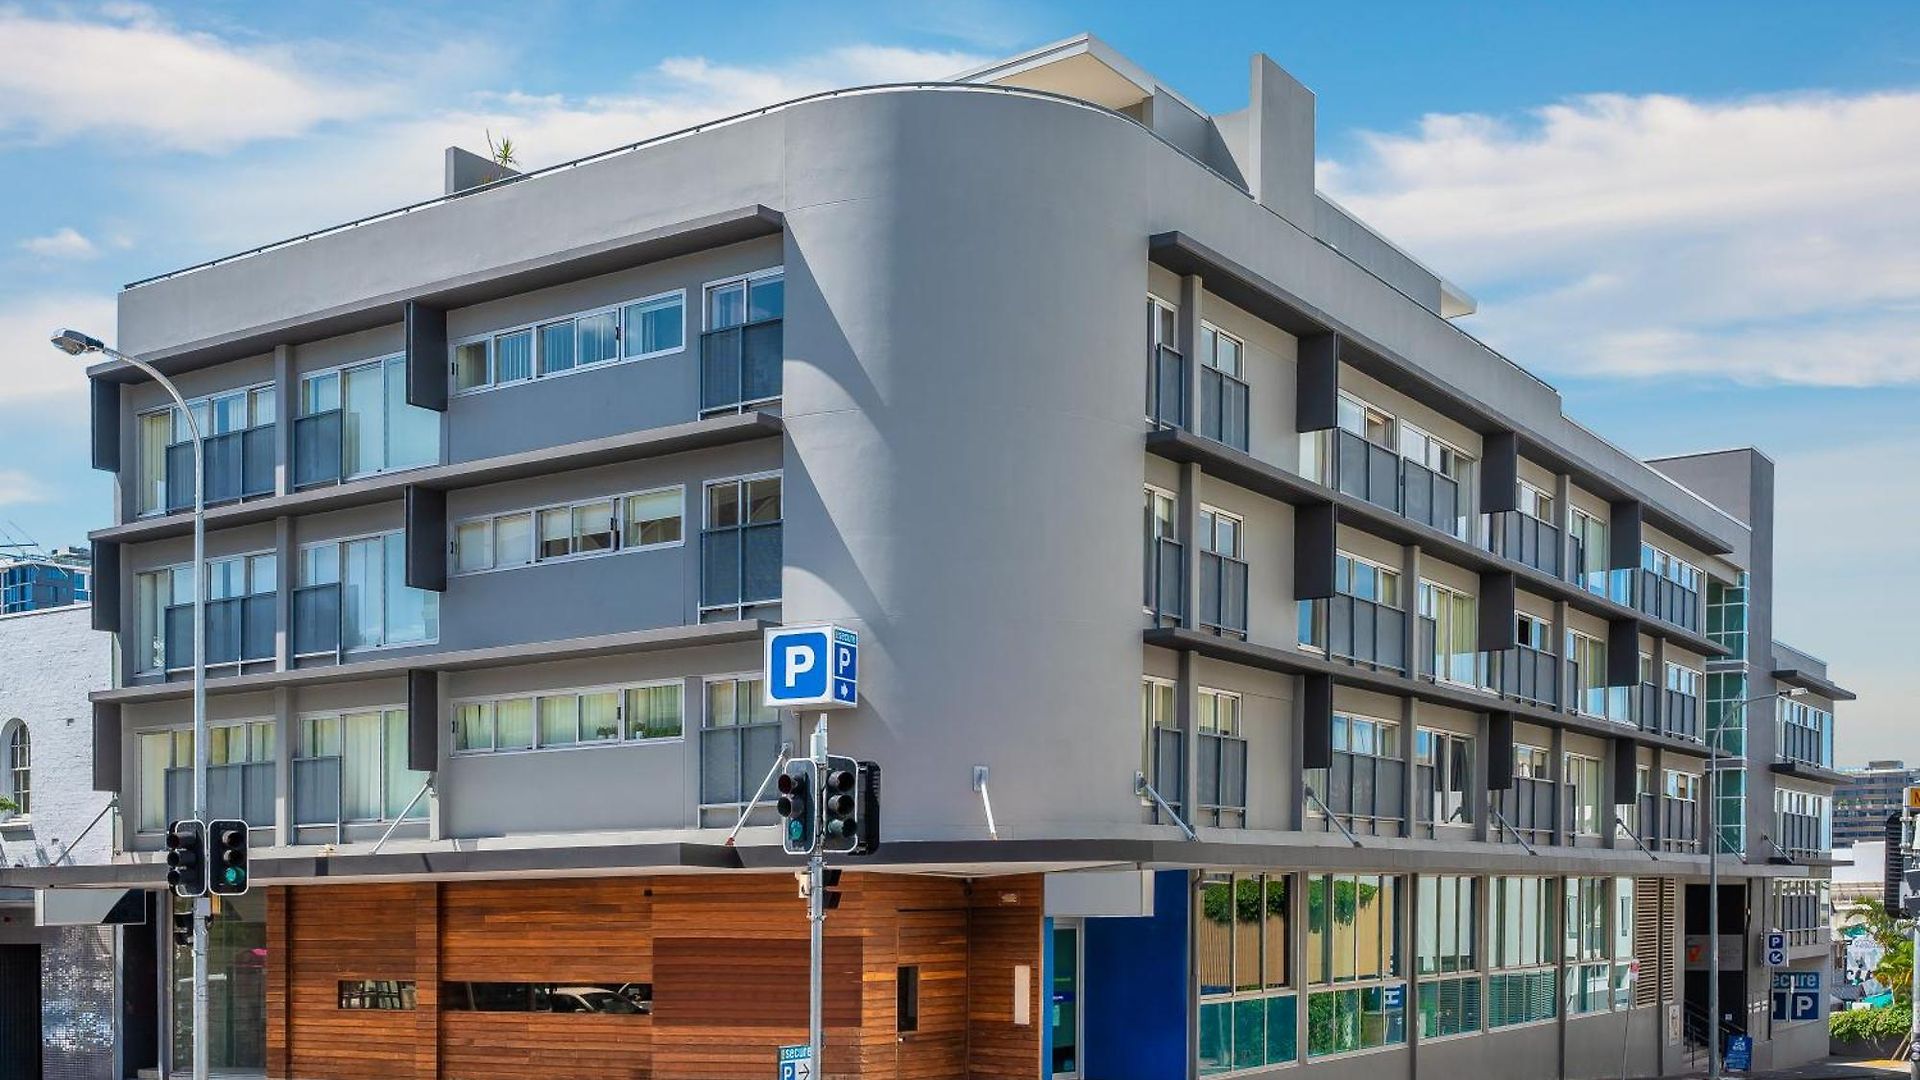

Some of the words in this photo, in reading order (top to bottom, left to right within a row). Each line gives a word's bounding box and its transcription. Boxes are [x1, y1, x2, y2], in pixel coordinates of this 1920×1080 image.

[785, 645, 815, 688] P
[840, 647, 850, 674] P
[1773, 937, 1780, 947] P
[1773, 973, 1817, 987] ecure
[1796, 995, 1814, 1017] P
[784, 1066, 793, 1080] P
